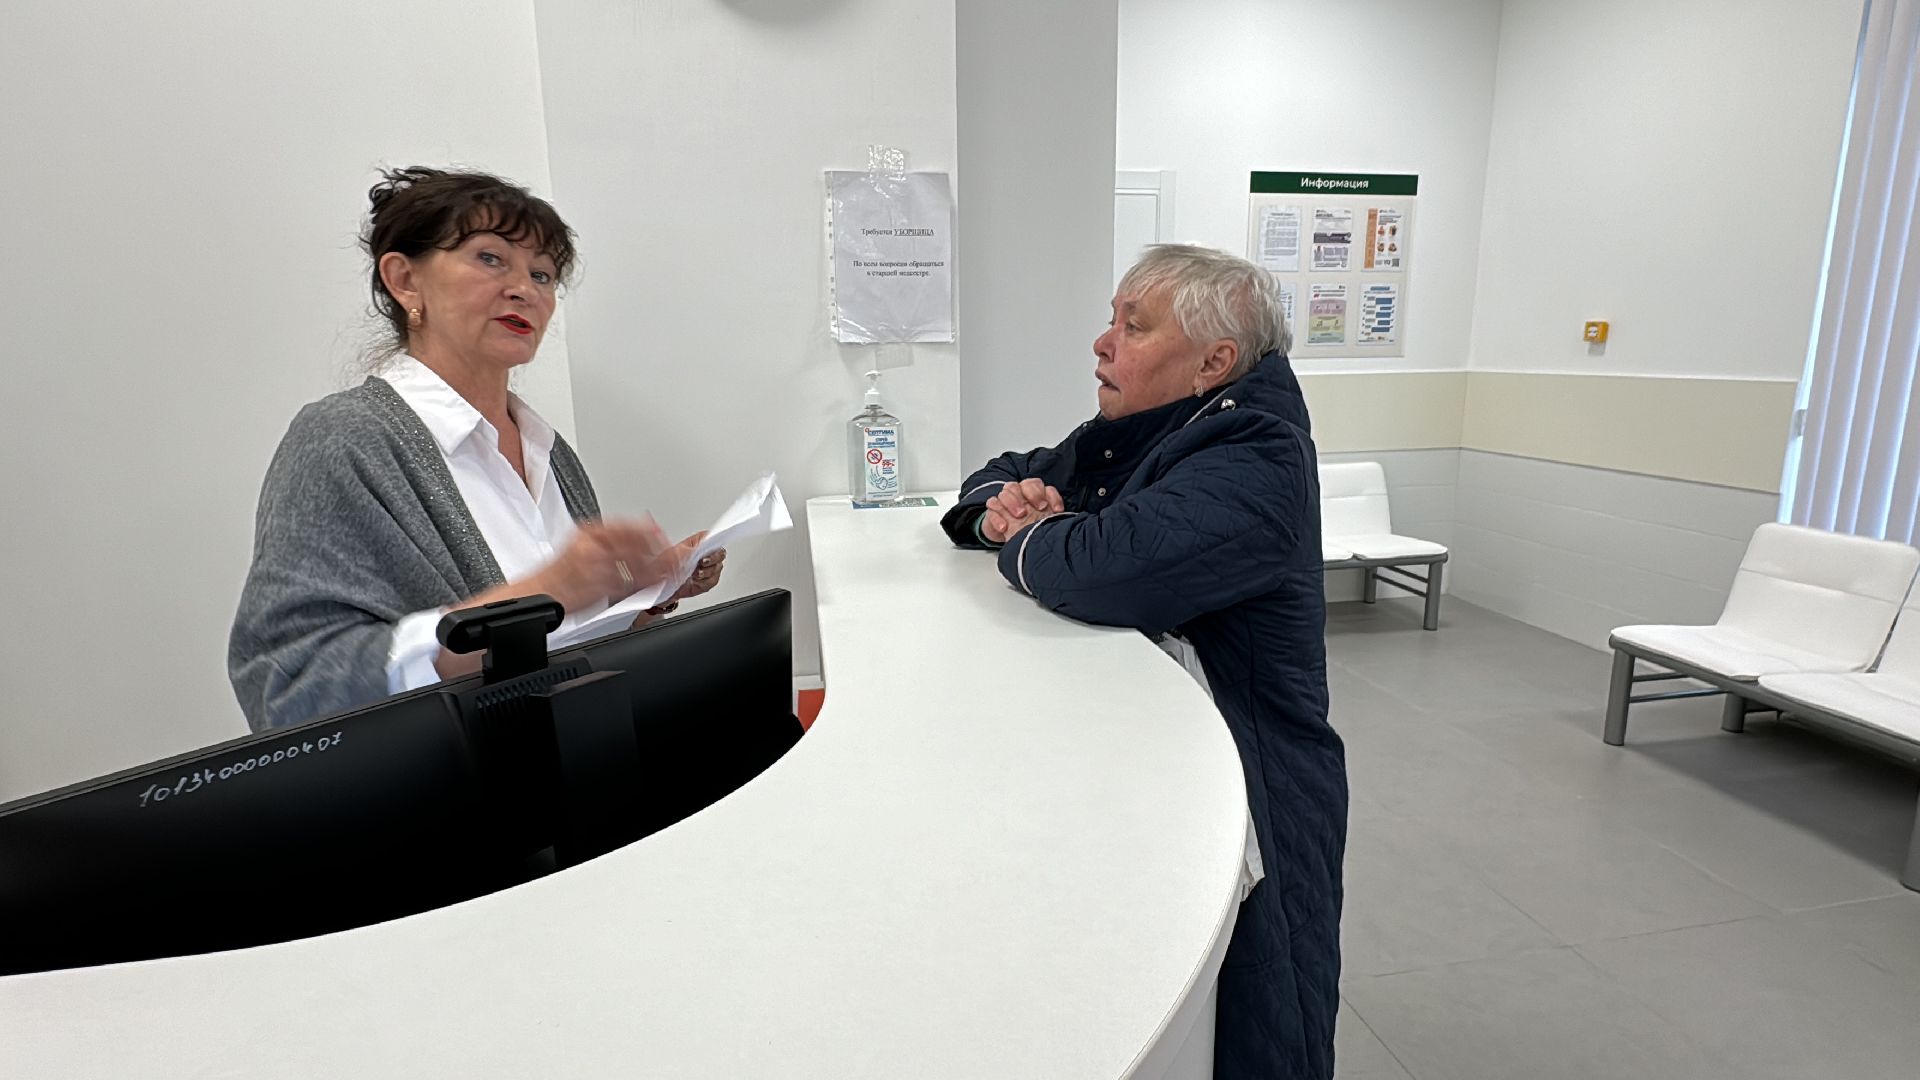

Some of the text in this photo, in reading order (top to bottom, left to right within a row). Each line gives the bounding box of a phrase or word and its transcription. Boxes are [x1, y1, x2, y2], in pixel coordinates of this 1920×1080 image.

[1301, 177, 1369, 190] Информация
[861, 228, 935, 237] Требуется УБОРЩИЦА
[908, 260, 944, 268] обращаться
[872, 269, 897, 277] старшей
[139, 731, 343, 808] 10134000000407
